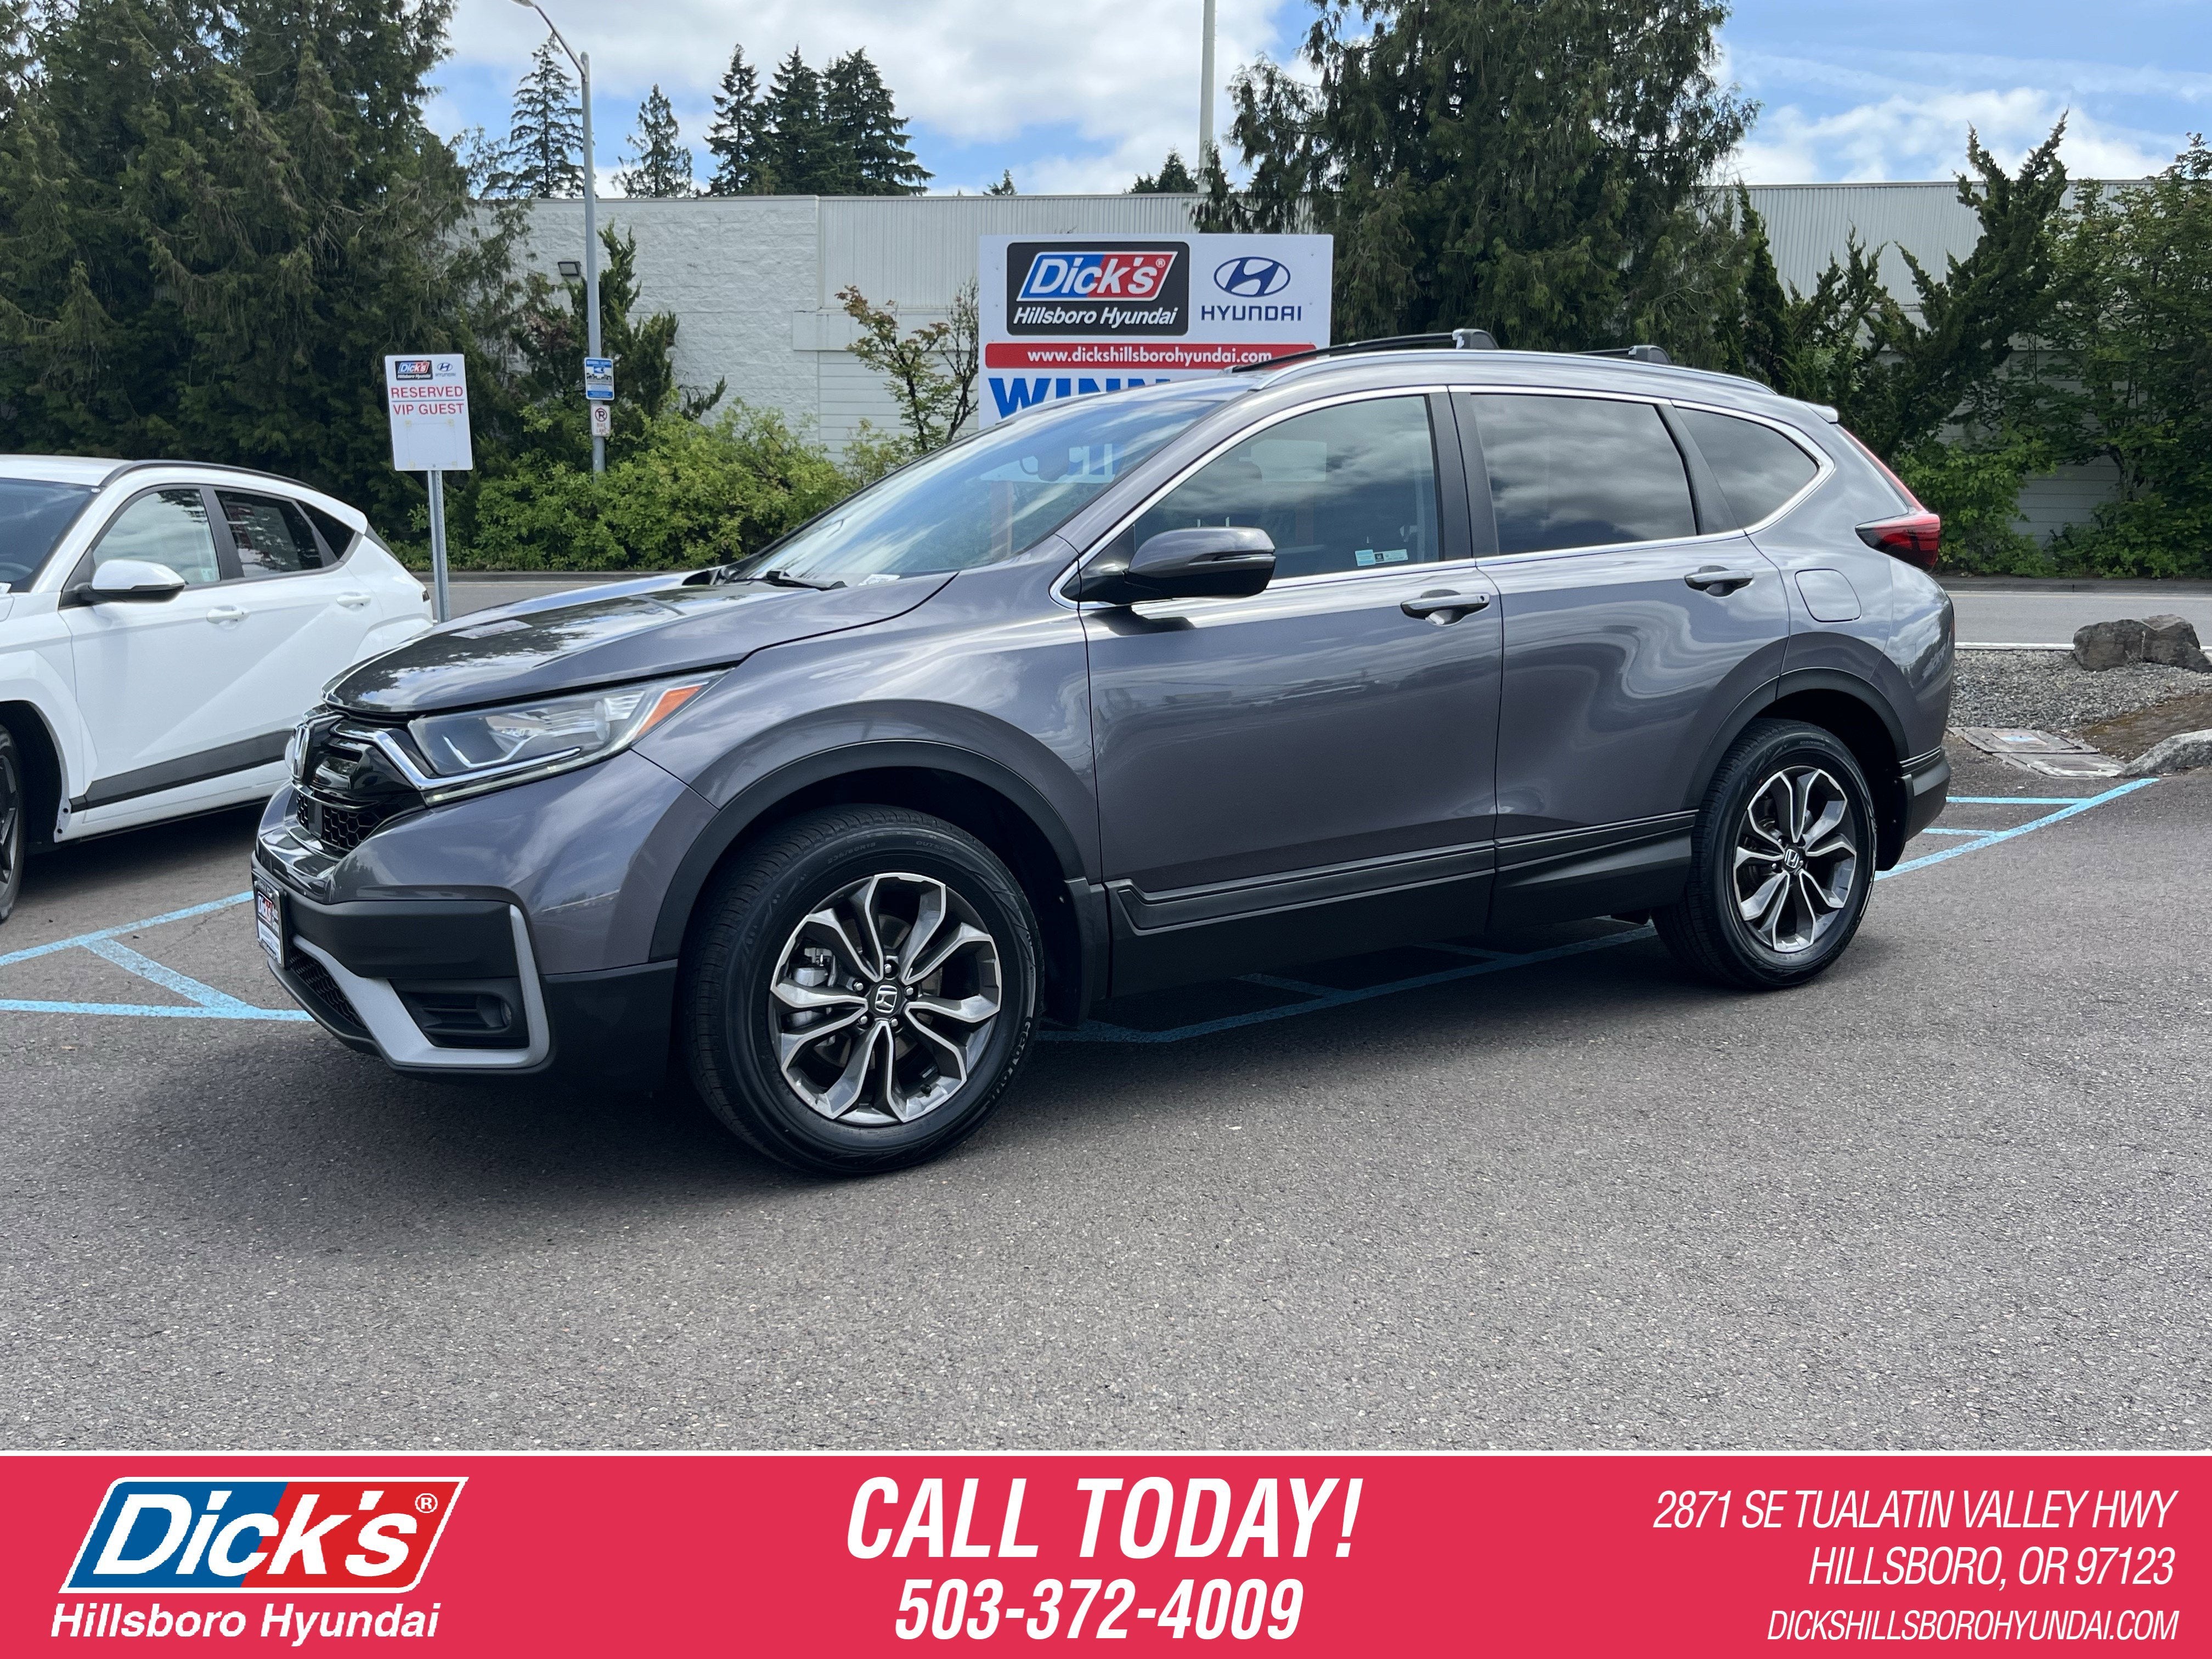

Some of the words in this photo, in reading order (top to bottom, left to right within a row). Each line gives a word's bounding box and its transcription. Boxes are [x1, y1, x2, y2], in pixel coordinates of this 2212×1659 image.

[1013, 307, 1097, 325] Hillsboro
[1099, 307, 1178, 329] Hyundai
[1201, 305, 1301, 321] HYUNDAI
[1027, 346, 1272, 367] www.dickshillsborohyundai.com
[391, 386, 463, 398] RESERVED
[393, 404, 414, 415] VIP
[419, 403, 464, 415] GUEST
